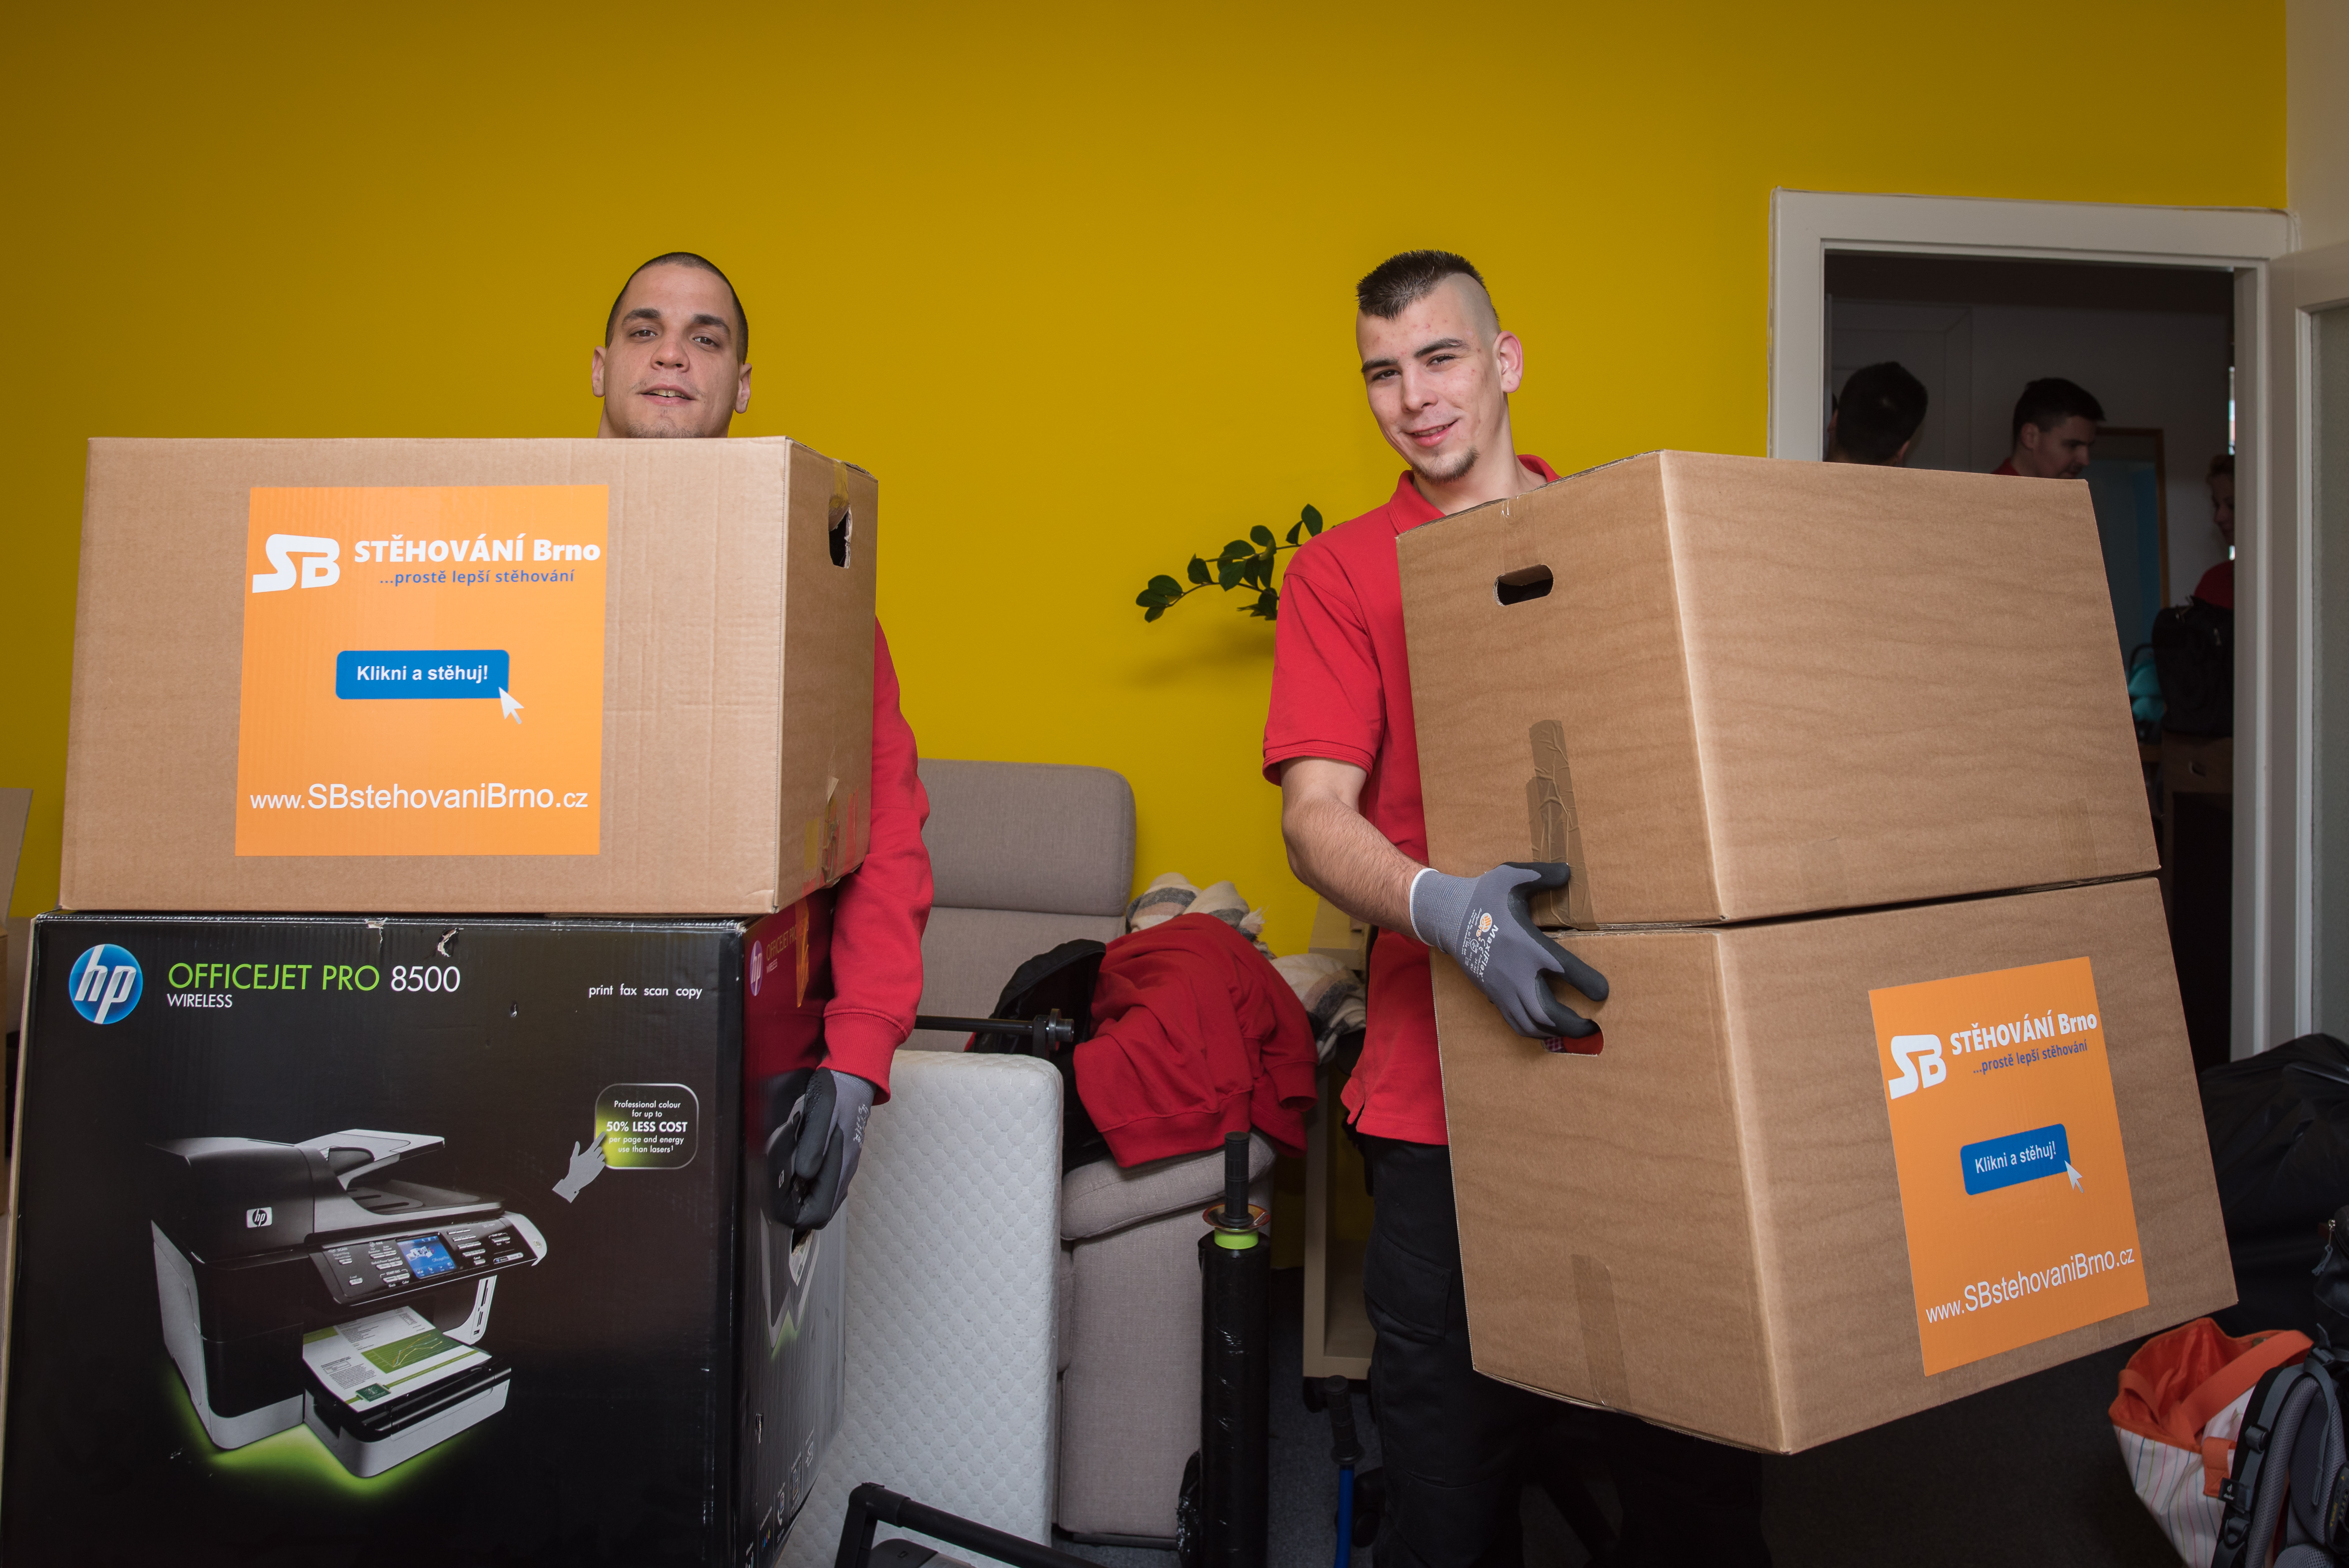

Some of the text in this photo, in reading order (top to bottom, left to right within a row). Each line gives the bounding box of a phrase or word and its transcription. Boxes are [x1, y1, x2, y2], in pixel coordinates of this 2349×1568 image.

[355, 533, 600, 562] STĚHOVÁNÍ Brno
[252, 534, 340, 593] SB
[380, 569, 574, 586] ...prostě lepší stěhování
[358, 665, 488, 683] Klikni a stěhuj!
[250, 783, 588, 808] www.SBstehovaniBrno.cz
[75, 944, 136, 1024] hp
[169, 963, 460, 992] OFFICEJET PRO 8500
[589, 985, 613, 998] print
[620, 983, 637, 995] fax
[676, 988, 702, 999] copy
[167, 994, 232, 1008] WIRELESS
[1950, 1010, 2097, 1055] STĚHOVÁNÍ Brno
[1888, 1035, 1946, 1099] SB
[1973, 1039, 2087, 1075] ...prostě lepší stěhování
[607, 1121, 688, 1132] 50% LESS COST
[1975, 1141, 2056, 1173] Klikni a stěhuj!
[254, 1209, 265, 1227] hp
[1926, 1249, 2135, 1323] www.SBstehovaniBrno.cz
